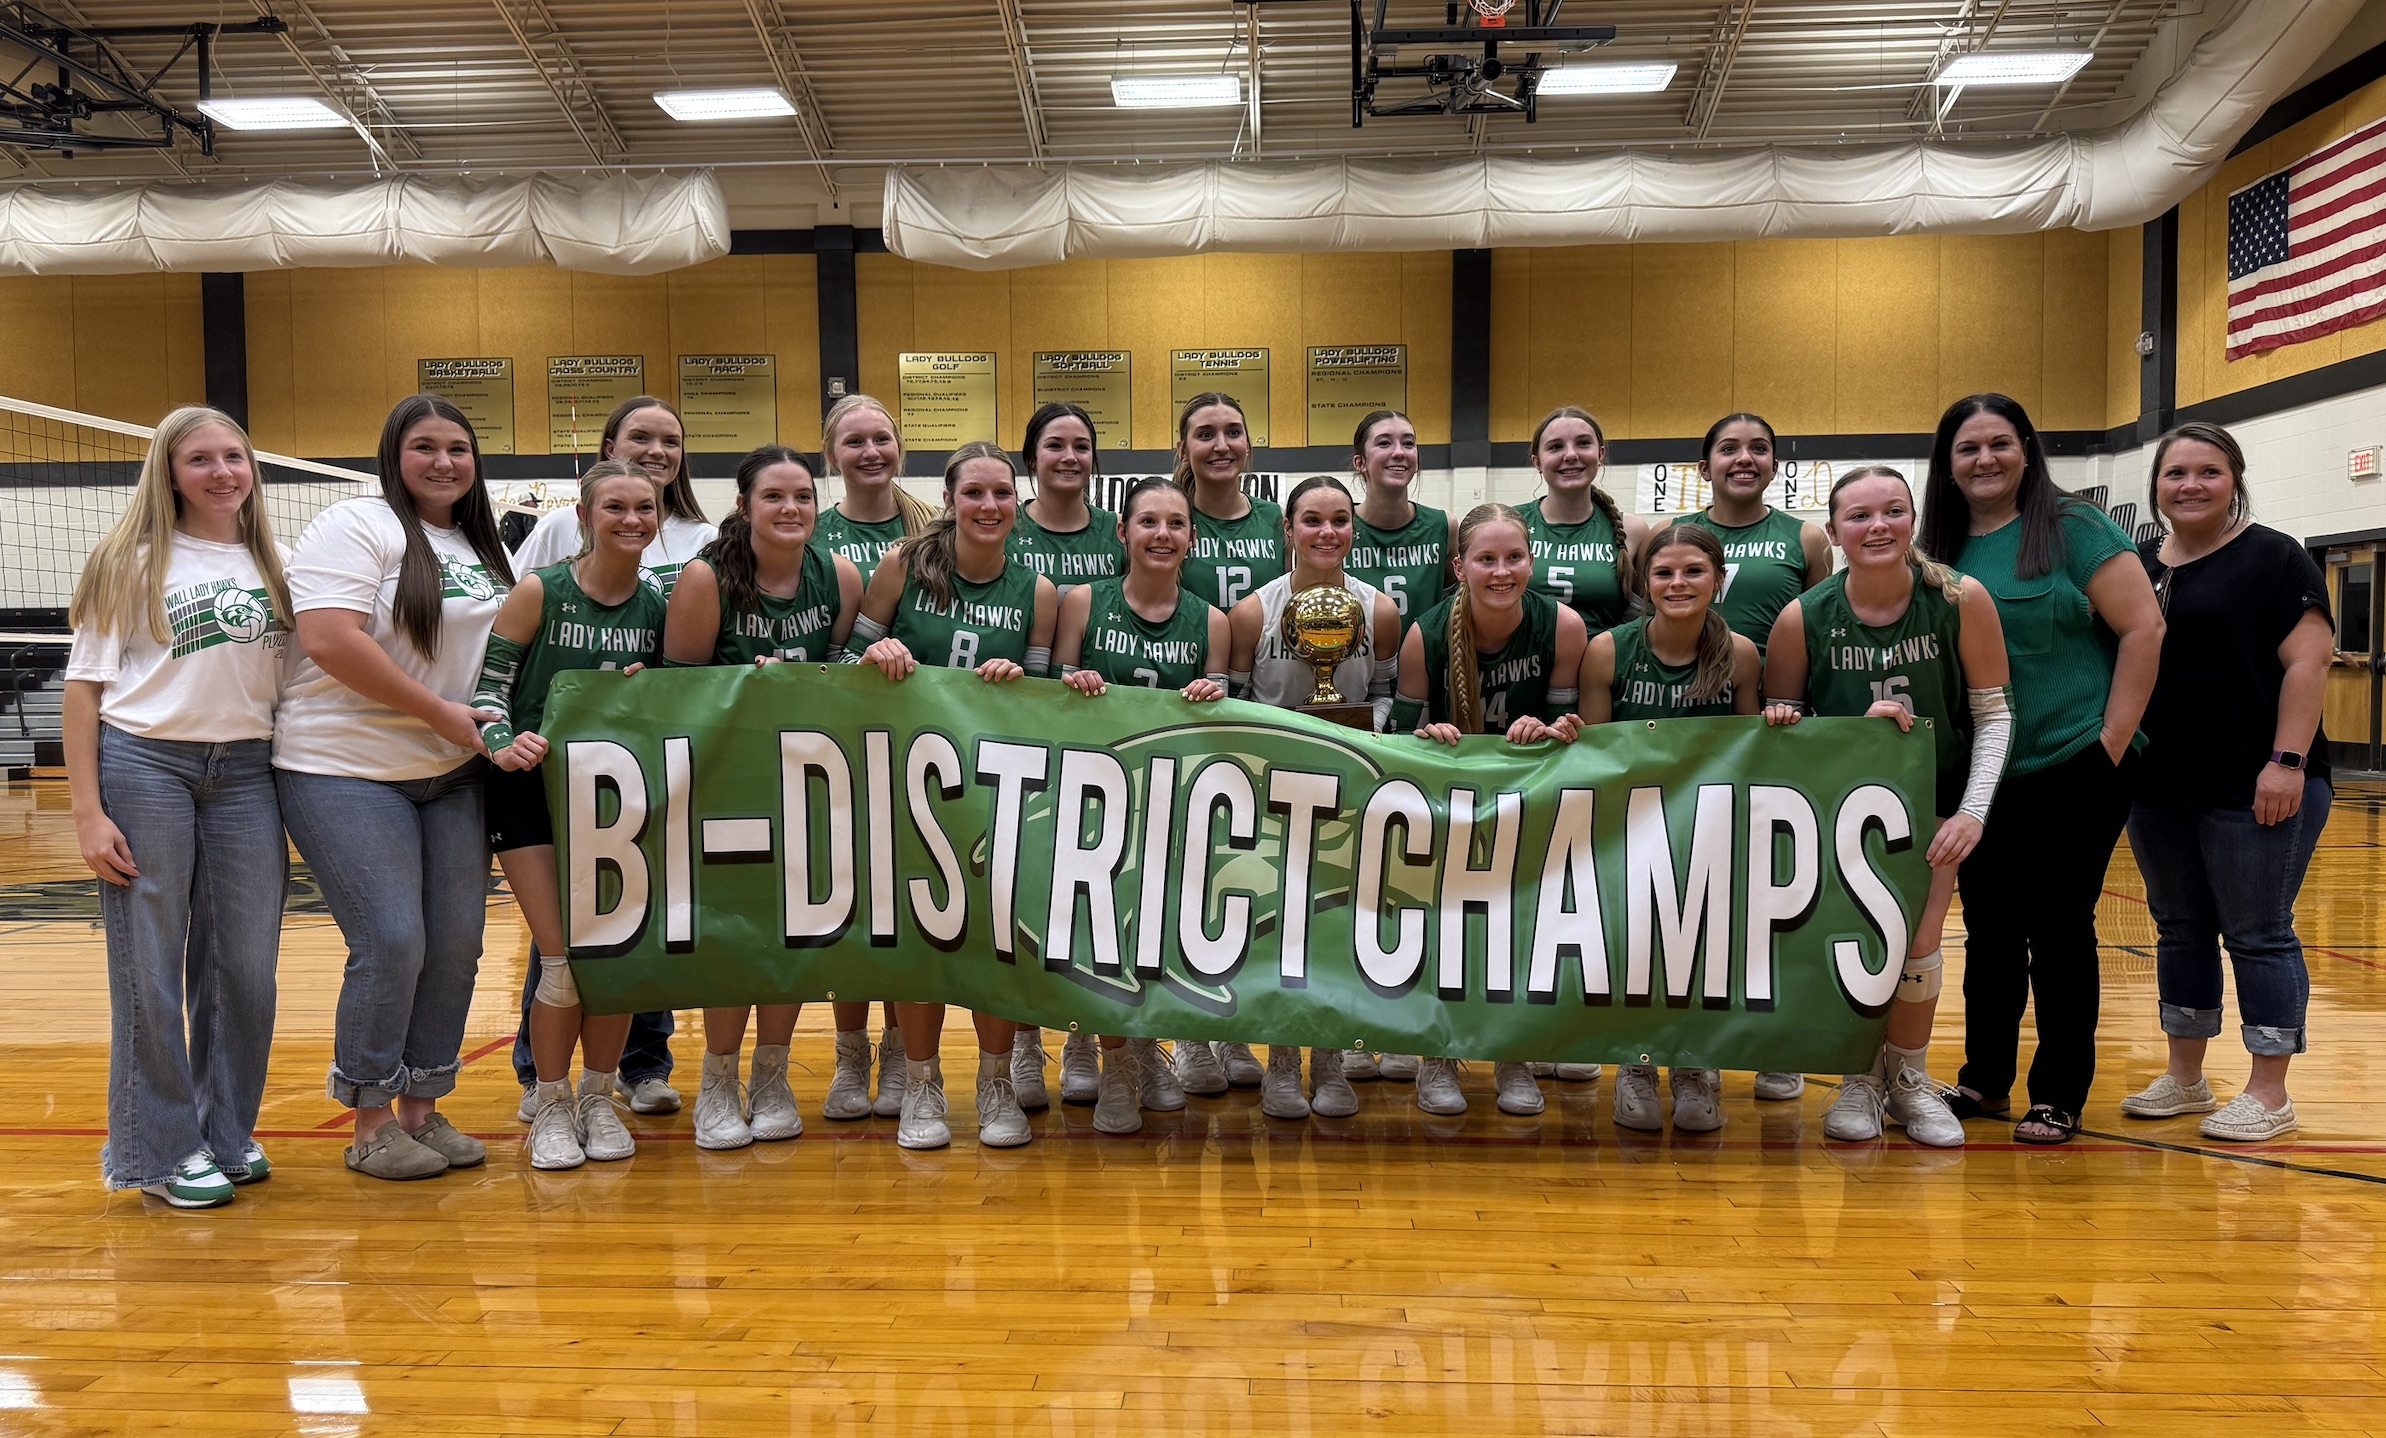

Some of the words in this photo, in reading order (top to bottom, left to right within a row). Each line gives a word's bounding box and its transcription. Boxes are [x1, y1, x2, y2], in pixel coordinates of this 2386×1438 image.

[685, 357, 713, 366] LADY
[716, 356, 768, 366] BULLDOG
[905, 355, 933, 363] LADY
[937, 354, 988, 363] BULLDOG
[1040, 353, 1069, 363] LADY
[1072, 352, 1124, 362] BULLDOG
[1178, 351, 1207, 361] LADY
[1209, 350, 1262, 360] BULLDOG
[1314, 348, 1344, 358] LADY
[1347, 346, 1400, 357] BULLDOG
[1315, 356, 1398, 366] POWERLIFTING
[425, 360, 453, 369] LADY
[455, 359, 506, 369] BULLDOG
[549, 367, 585, 376] CROSS
[589, 366, 640, 375] COUNTRY
[554, 359, 581, 367] LADY
[584, 358, 636, 367] BULLDOG
[710, 365, 745, 375] TRACK
[932, 363, 960, 371] GOLF
[1053, 361, 1112, 371] SOFTBALL
[1200, 359, 1241, 369] TENNIS
[430, 368, 501, 378] BASKETBALL
[2354, 453, 2374, 472] EXIT
[1225, 538, 1277, 560] HAWKS
[1343, 546, 1381, 569] LADY
[1386, 542, 1440, 568] HAWKS
[1556, 543, 1615, 563] HAWKS
[1723, 541, 1786, 560] HAWKS
[1061, 553, 1116, 576] HAWKS
[1215, 566, 1252, 608] 12
[1547, 566, 1575, 604] 5
[1714, 562, 1740, 604] 7
[164, 590, 190, 611] WALL
[189, 582, 210, 600] LADY
[210, 577, 238, 594] HAWKS
[1383, 575, 1409, 616] 6
[735, 611, 776, 639] LADY
[780, 604, 832, 642] HAWKS
[962, 600, 1023, 632] HAWKS
[548, 620, 596, 651] LADY
[600, 626, 657, 654] HAWKS
[1094, 626, 1139, 657] LADY
[1142, 638, 1199, 665] HAWKS
[947, 629, 980, 671] 8
[1830, 645, 1876, 672] LADY
[1881, 632, 1940, 671] HAWKS
[1620, 678, 1666, 707] LADY
[566, 730, 1340, 984] BI-DISTRICT
[1354, 779, 1912, 1014] CHAMPS
